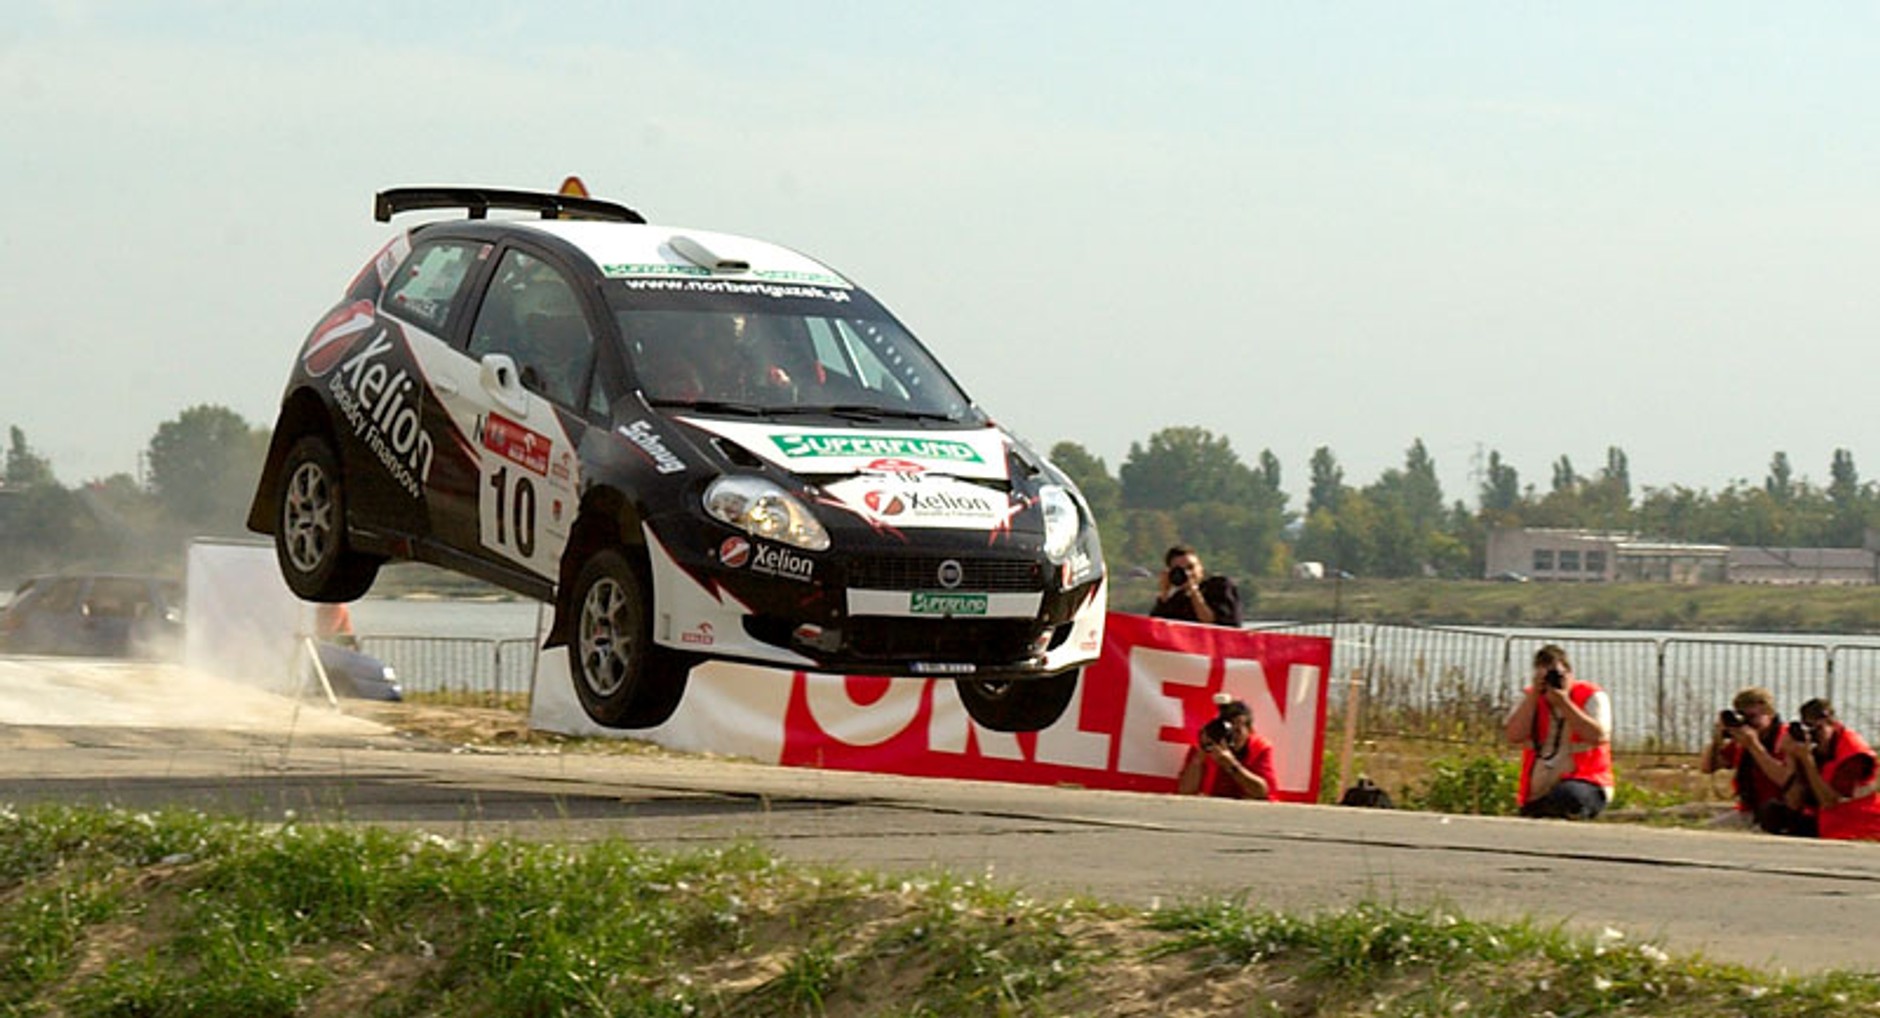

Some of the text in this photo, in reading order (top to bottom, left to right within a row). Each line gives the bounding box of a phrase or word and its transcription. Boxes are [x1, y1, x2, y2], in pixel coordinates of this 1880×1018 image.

[343, 328, 433, 483] Xelion
[782, 435, 974, 458] SUPERFUND
[490, 465, 535, 558] 10
[902, 491, 991, 511] Xelion
[753, 543, 814, 575] Xelion
